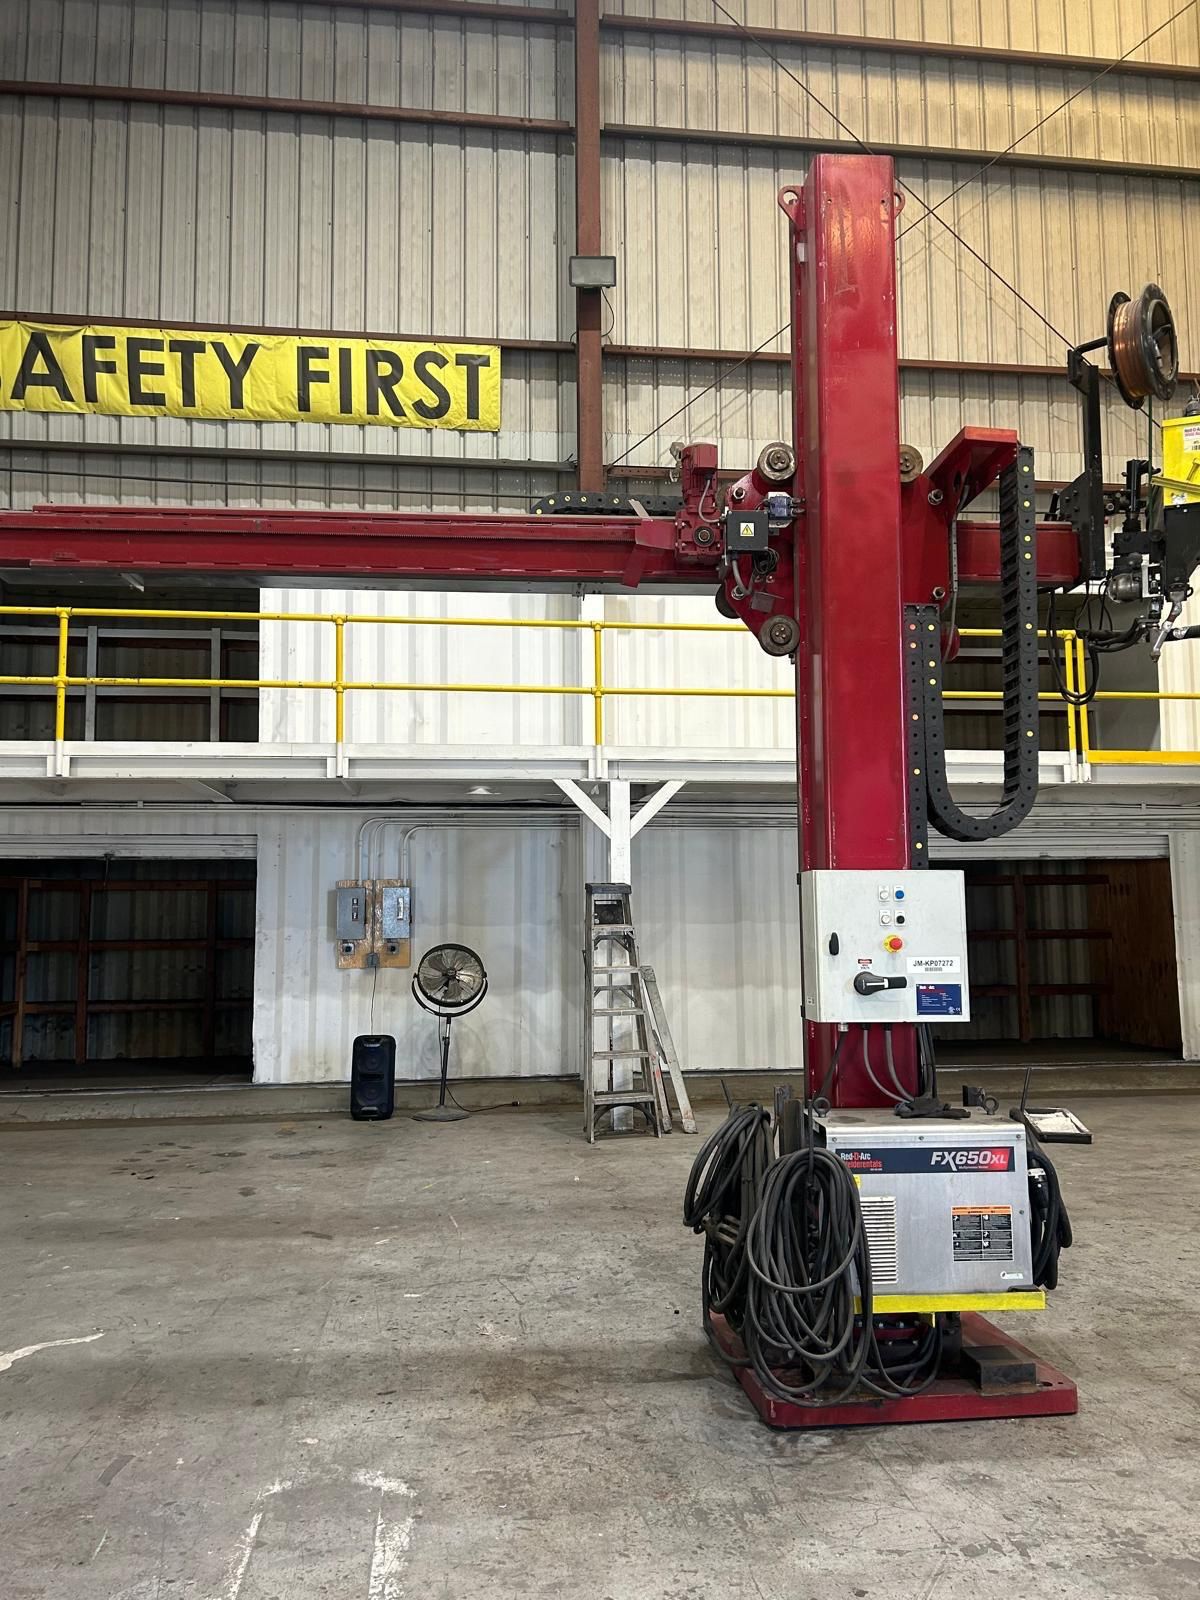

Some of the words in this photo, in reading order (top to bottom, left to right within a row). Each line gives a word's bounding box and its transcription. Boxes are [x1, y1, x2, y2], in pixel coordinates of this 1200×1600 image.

[0, 331, 260, 410] AFETY
[297, 345, 491, 420] FIRST
[845, 1160, 883, 1169] elderentals
